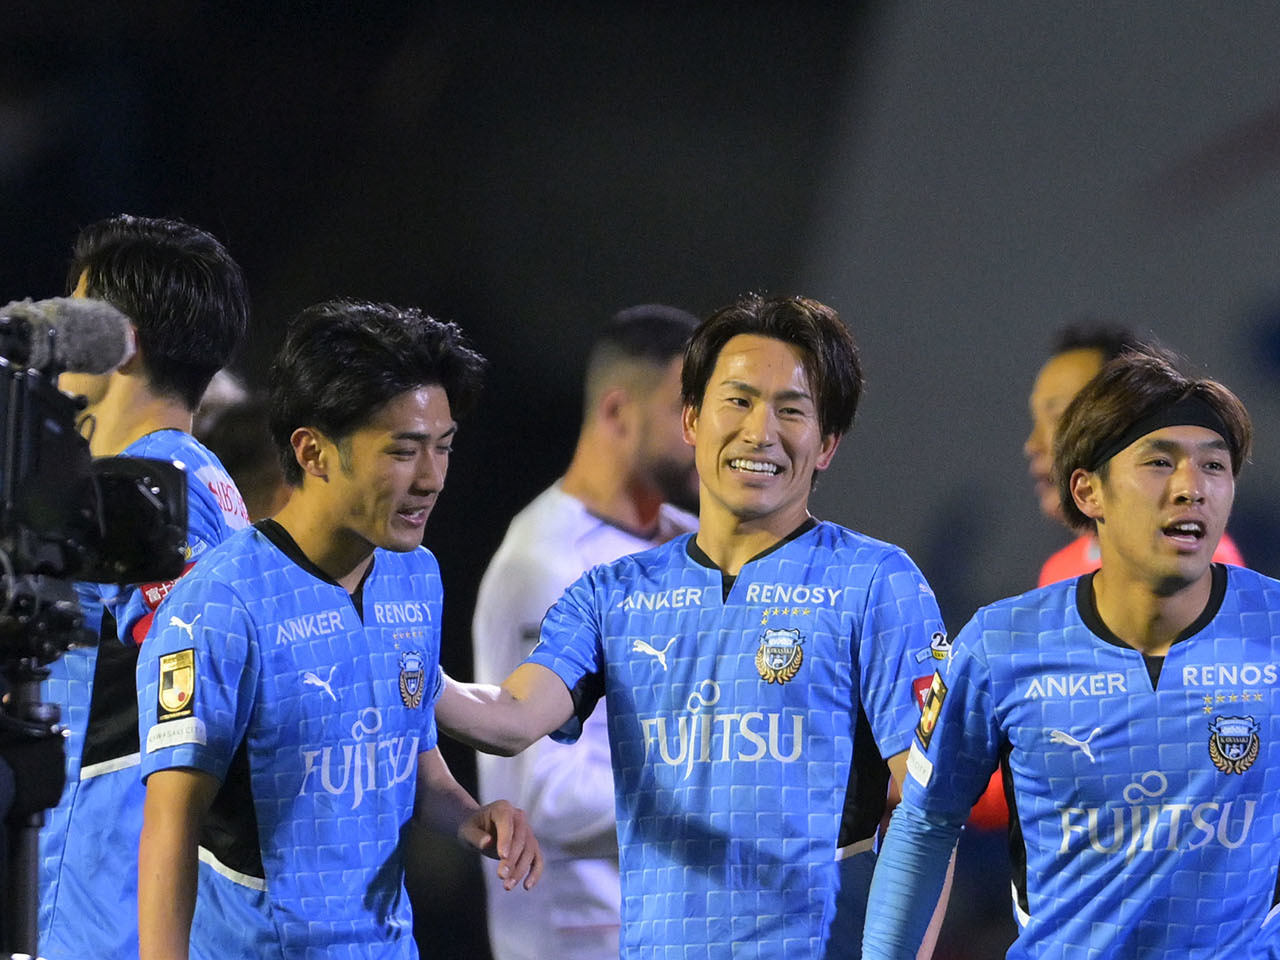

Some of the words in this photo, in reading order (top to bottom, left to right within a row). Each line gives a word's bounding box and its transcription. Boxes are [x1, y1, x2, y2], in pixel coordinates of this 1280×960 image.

[617, 589, 702, 611] ANKER
[746, 583, 842, 606] RENOSY
[276, 611, 345, 645] ANKER
[374, 603, 432, 624] RENOSY
[1024, 672, 1128, 698] ANKER
[640, 713, 804, 780] FUJITSU
[299, 737, 420, 810] FUJITSU
[1058, 801, 1257, 866] FUJITSU
